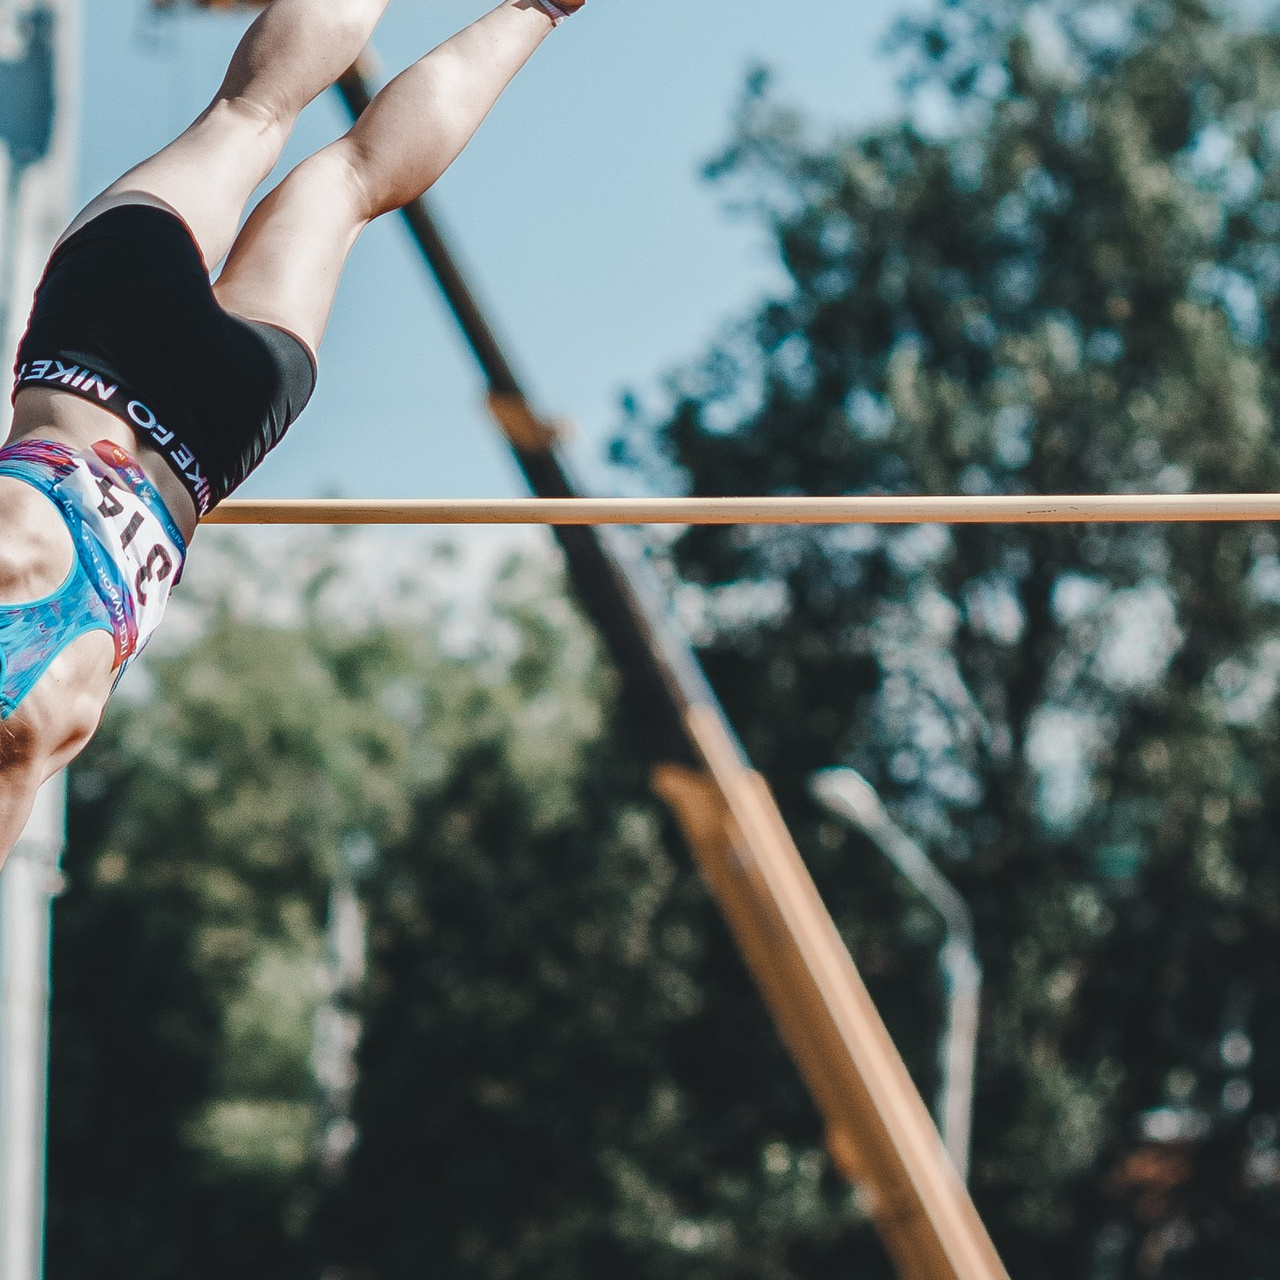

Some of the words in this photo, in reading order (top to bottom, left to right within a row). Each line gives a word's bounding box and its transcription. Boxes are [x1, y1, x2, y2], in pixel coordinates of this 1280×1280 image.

[23, 359, 119, 401] NIKE
[94, 474, 173, 608] 314
[96, 565, 126, 622] КУБОК
